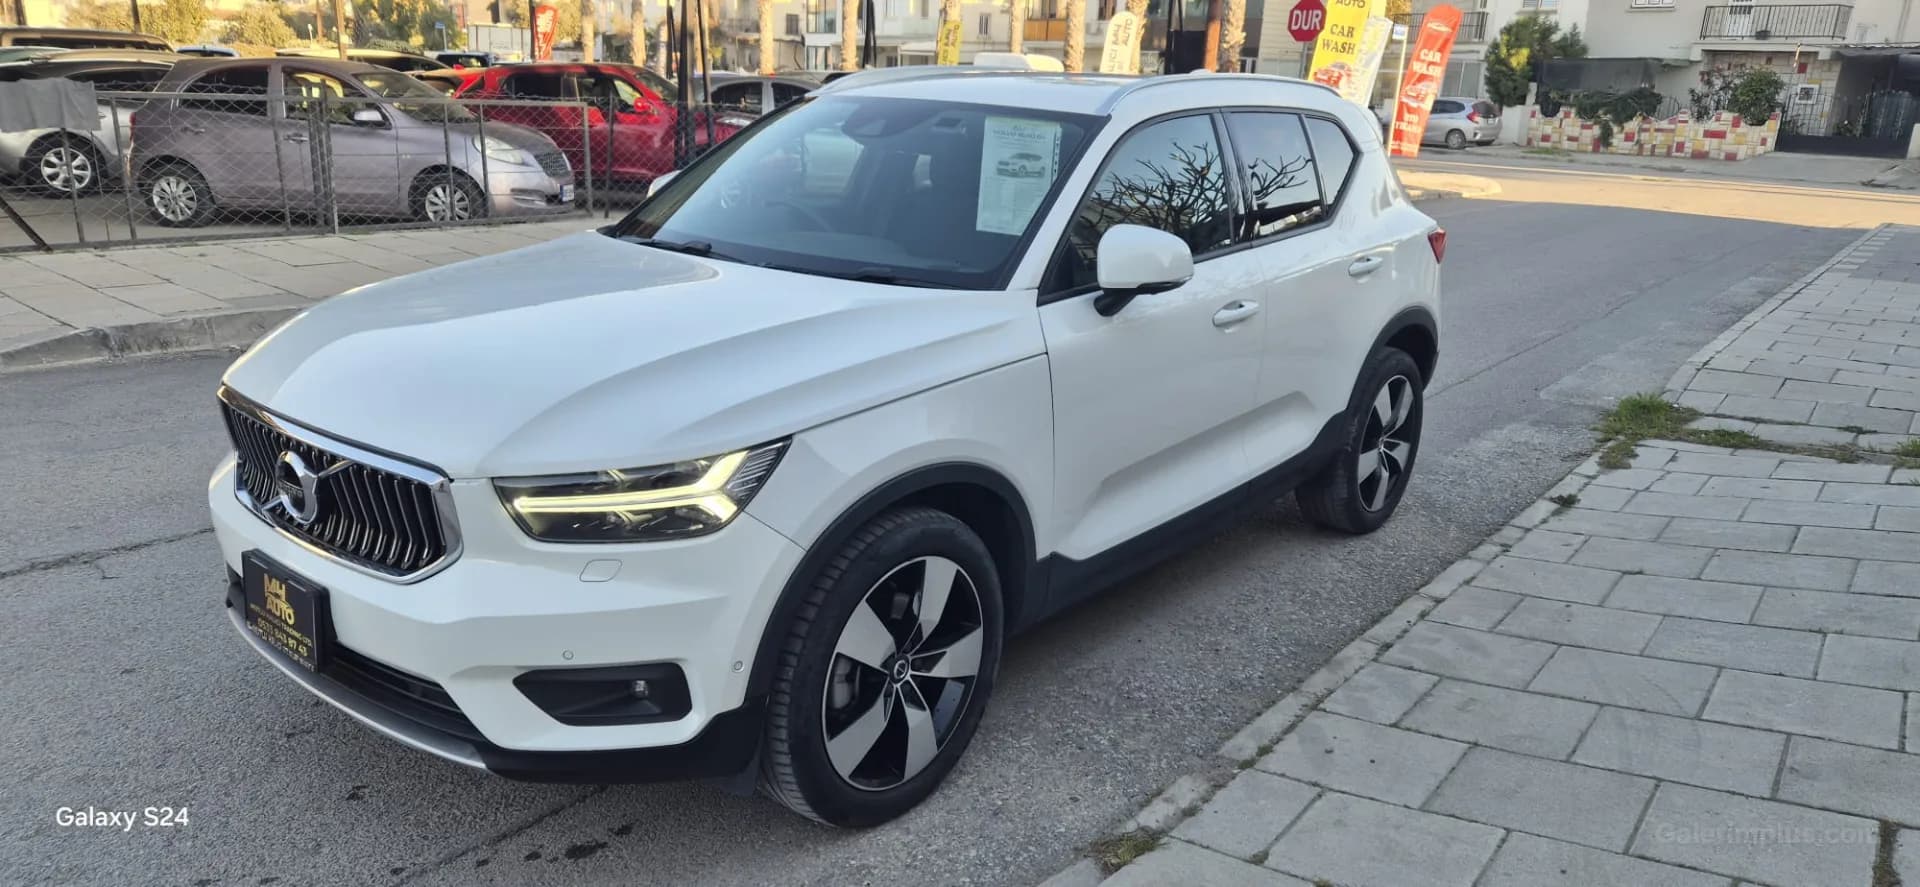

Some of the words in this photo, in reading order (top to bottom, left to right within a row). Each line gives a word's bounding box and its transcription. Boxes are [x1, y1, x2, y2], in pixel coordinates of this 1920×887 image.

[1291, 9, 1322, 31] DUR
[1122, 18, 1133, 47] AUTO
[1330, 24, 1355, 38] CAR
[1322, 39, 1356, 55] WASH
[1420, 49, 1442, 63] CAR
[1413, 61, 1443, 77] WASH
[264, 573, 286, 601] MH
[266, 597, 295, 625] AUTO
